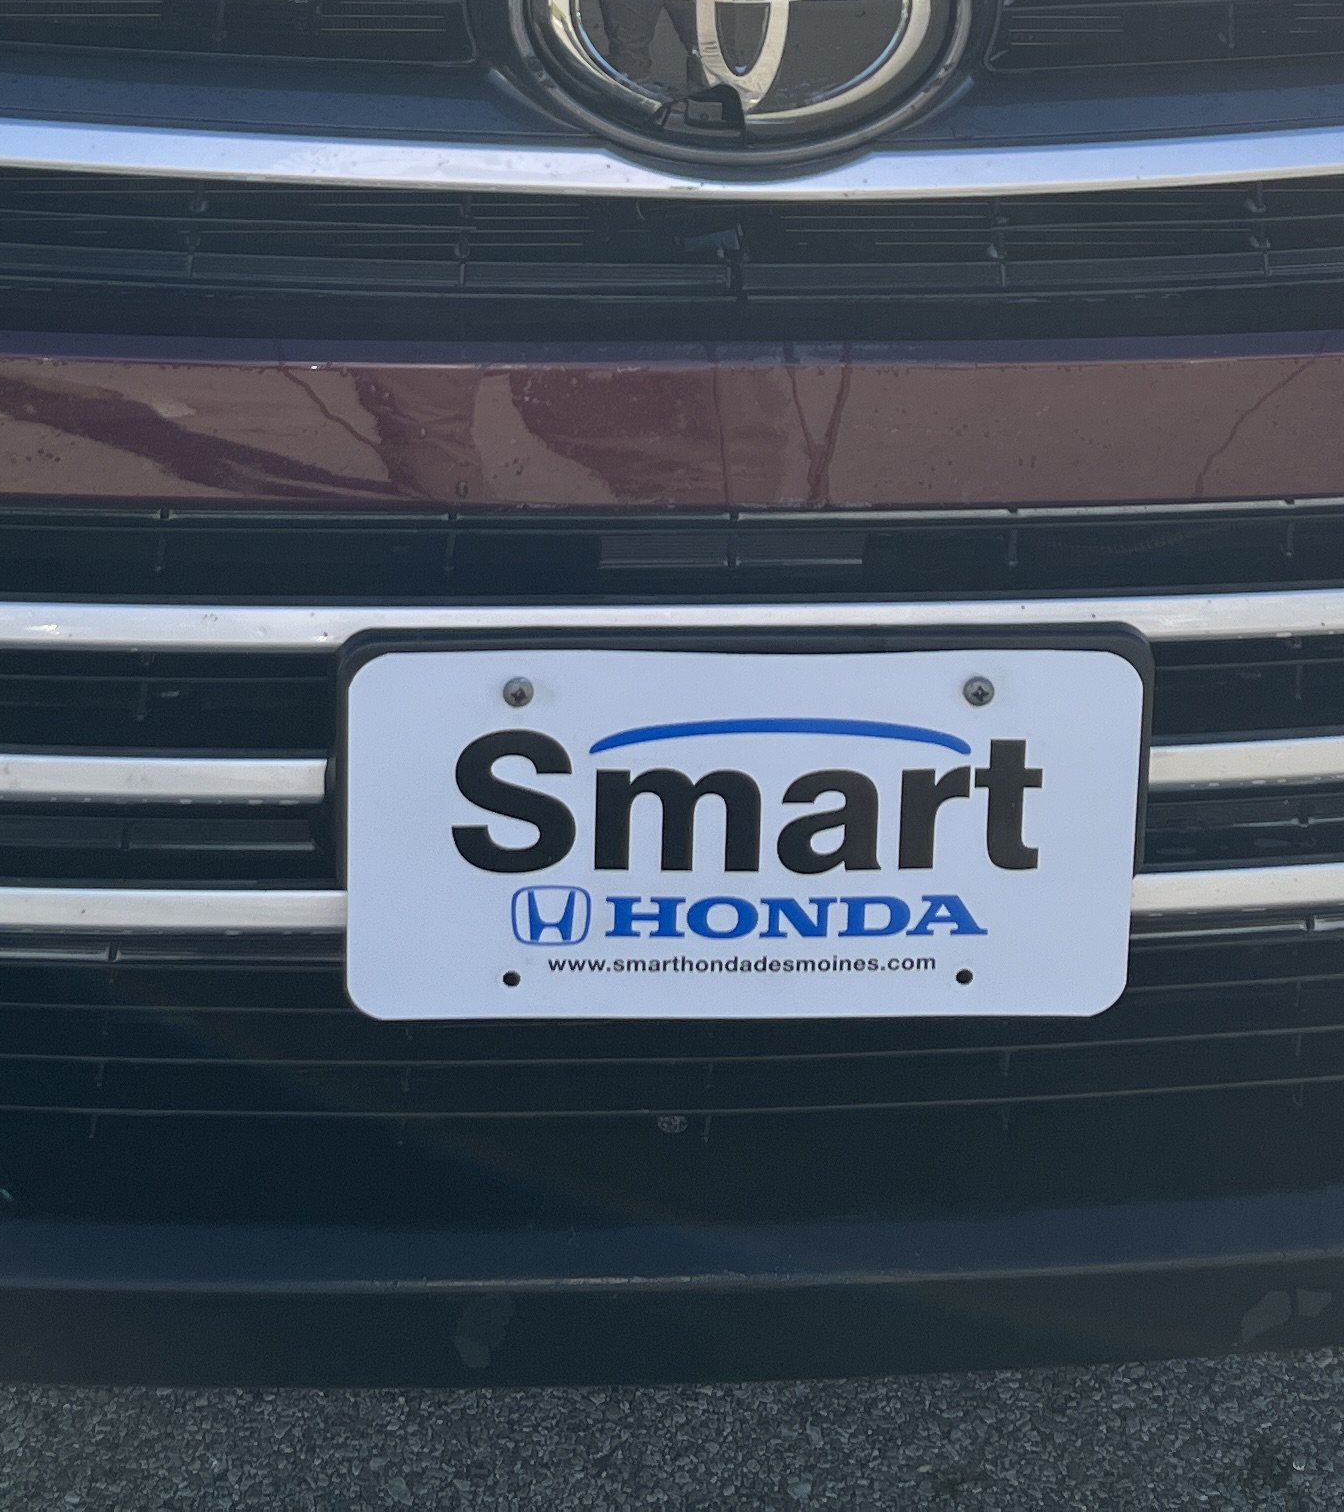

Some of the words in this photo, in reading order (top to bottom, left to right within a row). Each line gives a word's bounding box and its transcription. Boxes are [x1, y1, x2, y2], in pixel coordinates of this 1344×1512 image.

[450, 728, 1044, 875] Smart
[604, 894, 989, 941] HONDA
[547, 954, 938, 974] www.smarthondadesmoines.com
